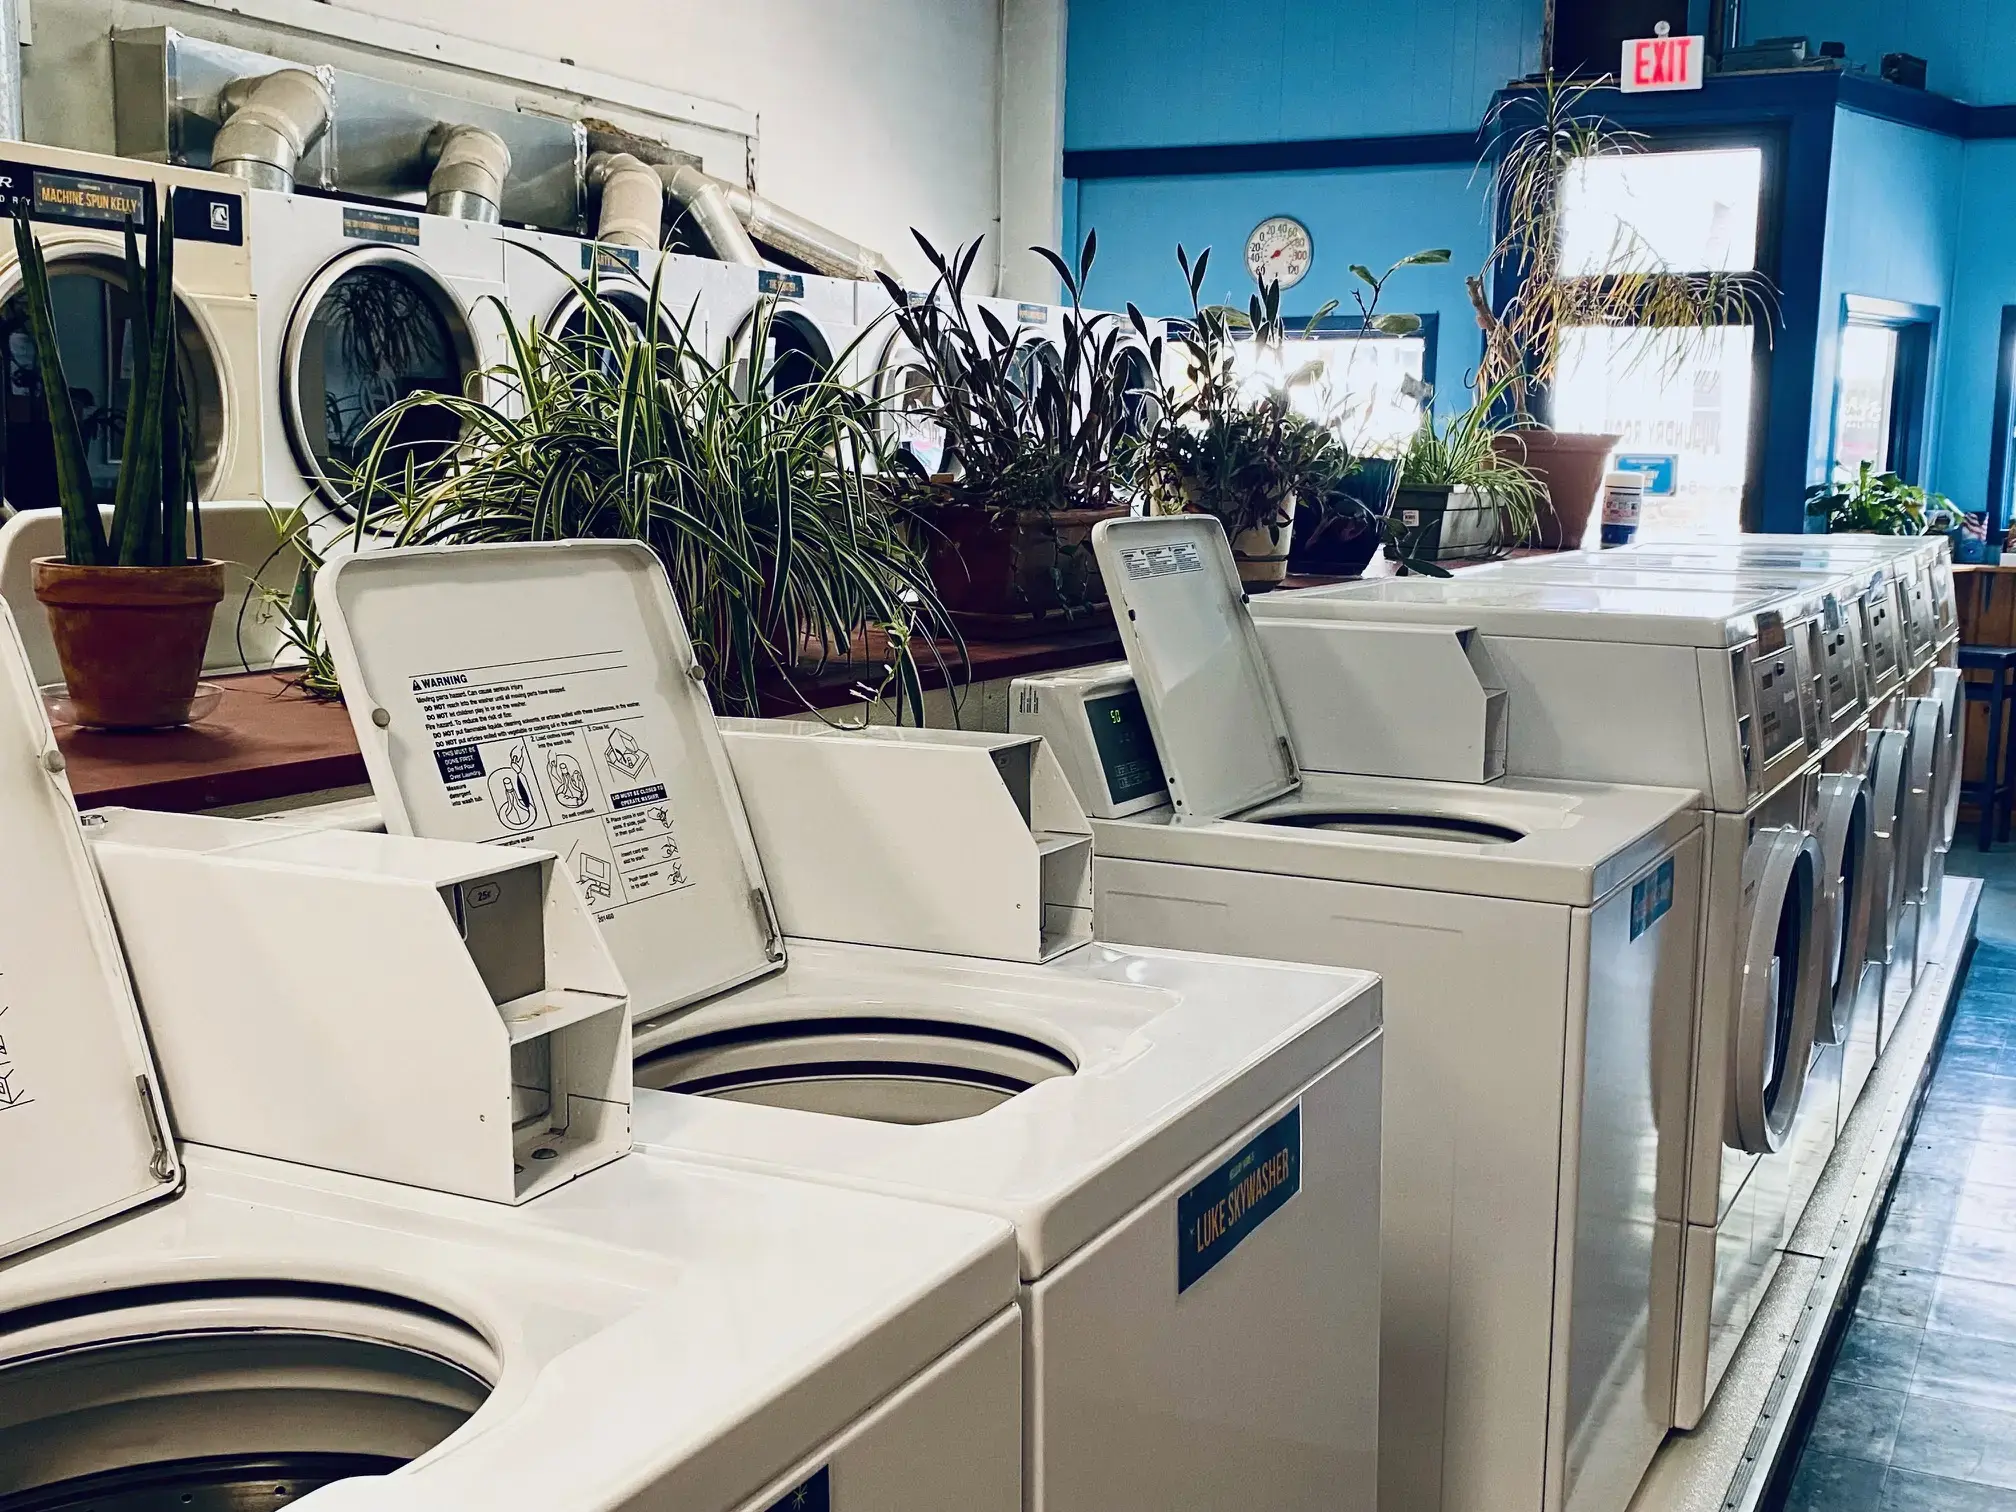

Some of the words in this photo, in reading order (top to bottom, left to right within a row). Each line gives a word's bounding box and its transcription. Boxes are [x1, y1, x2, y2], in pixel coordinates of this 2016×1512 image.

[1635, 39, 1691, 84] EXIT
[42, 187, 83, 206] MACHINE
[86, 193, 109, 209] SPUN
[111, 197, 138, 213] KELLY
[421, 674, 467, 688] WARNING
[433, 703, 445, 711] NOT
[1196, 1199, 1226, 1253] LUKE
[1228, 1147, 1289, 1226] SKYWASHER
